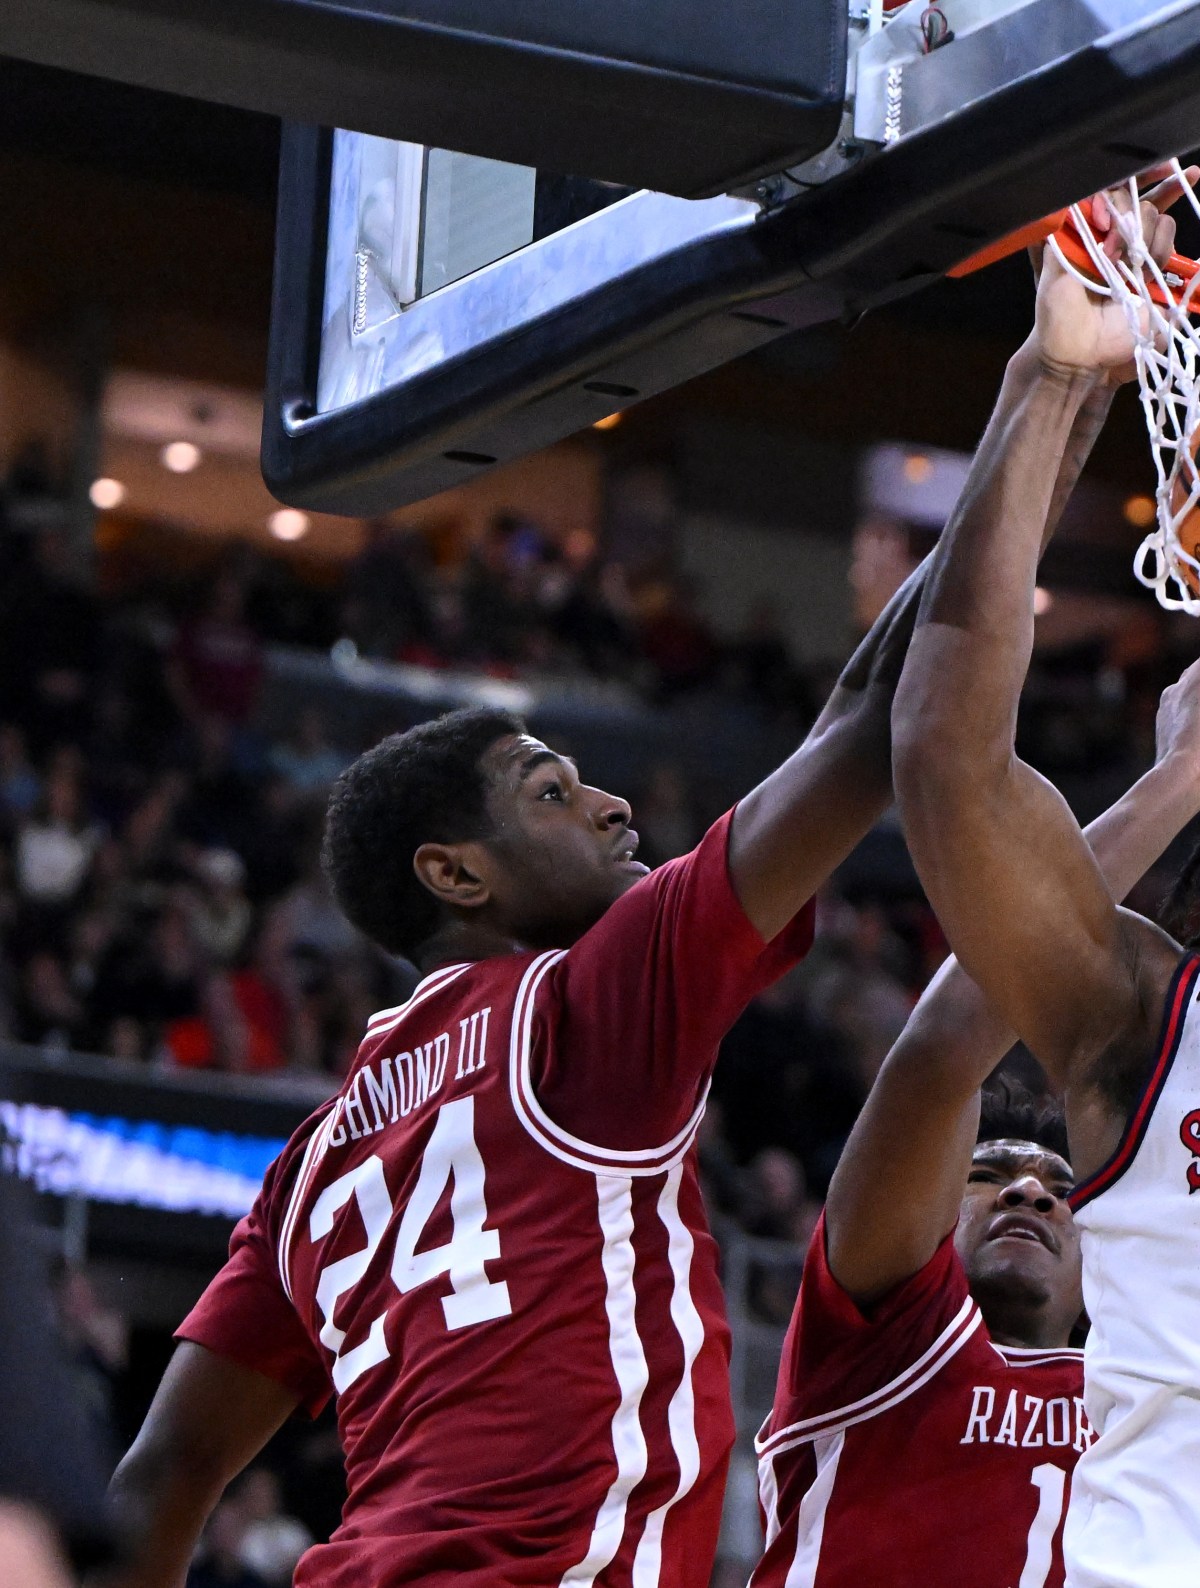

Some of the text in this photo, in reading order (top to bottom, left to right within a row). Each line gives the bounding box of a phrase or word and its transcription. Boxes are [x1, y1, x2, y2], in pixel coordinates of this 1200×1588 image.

[454, 1006, 492, 1080] III
[309, 1094, 513, 1397] 24
[1018, 1462, 1067, 1588] 1
